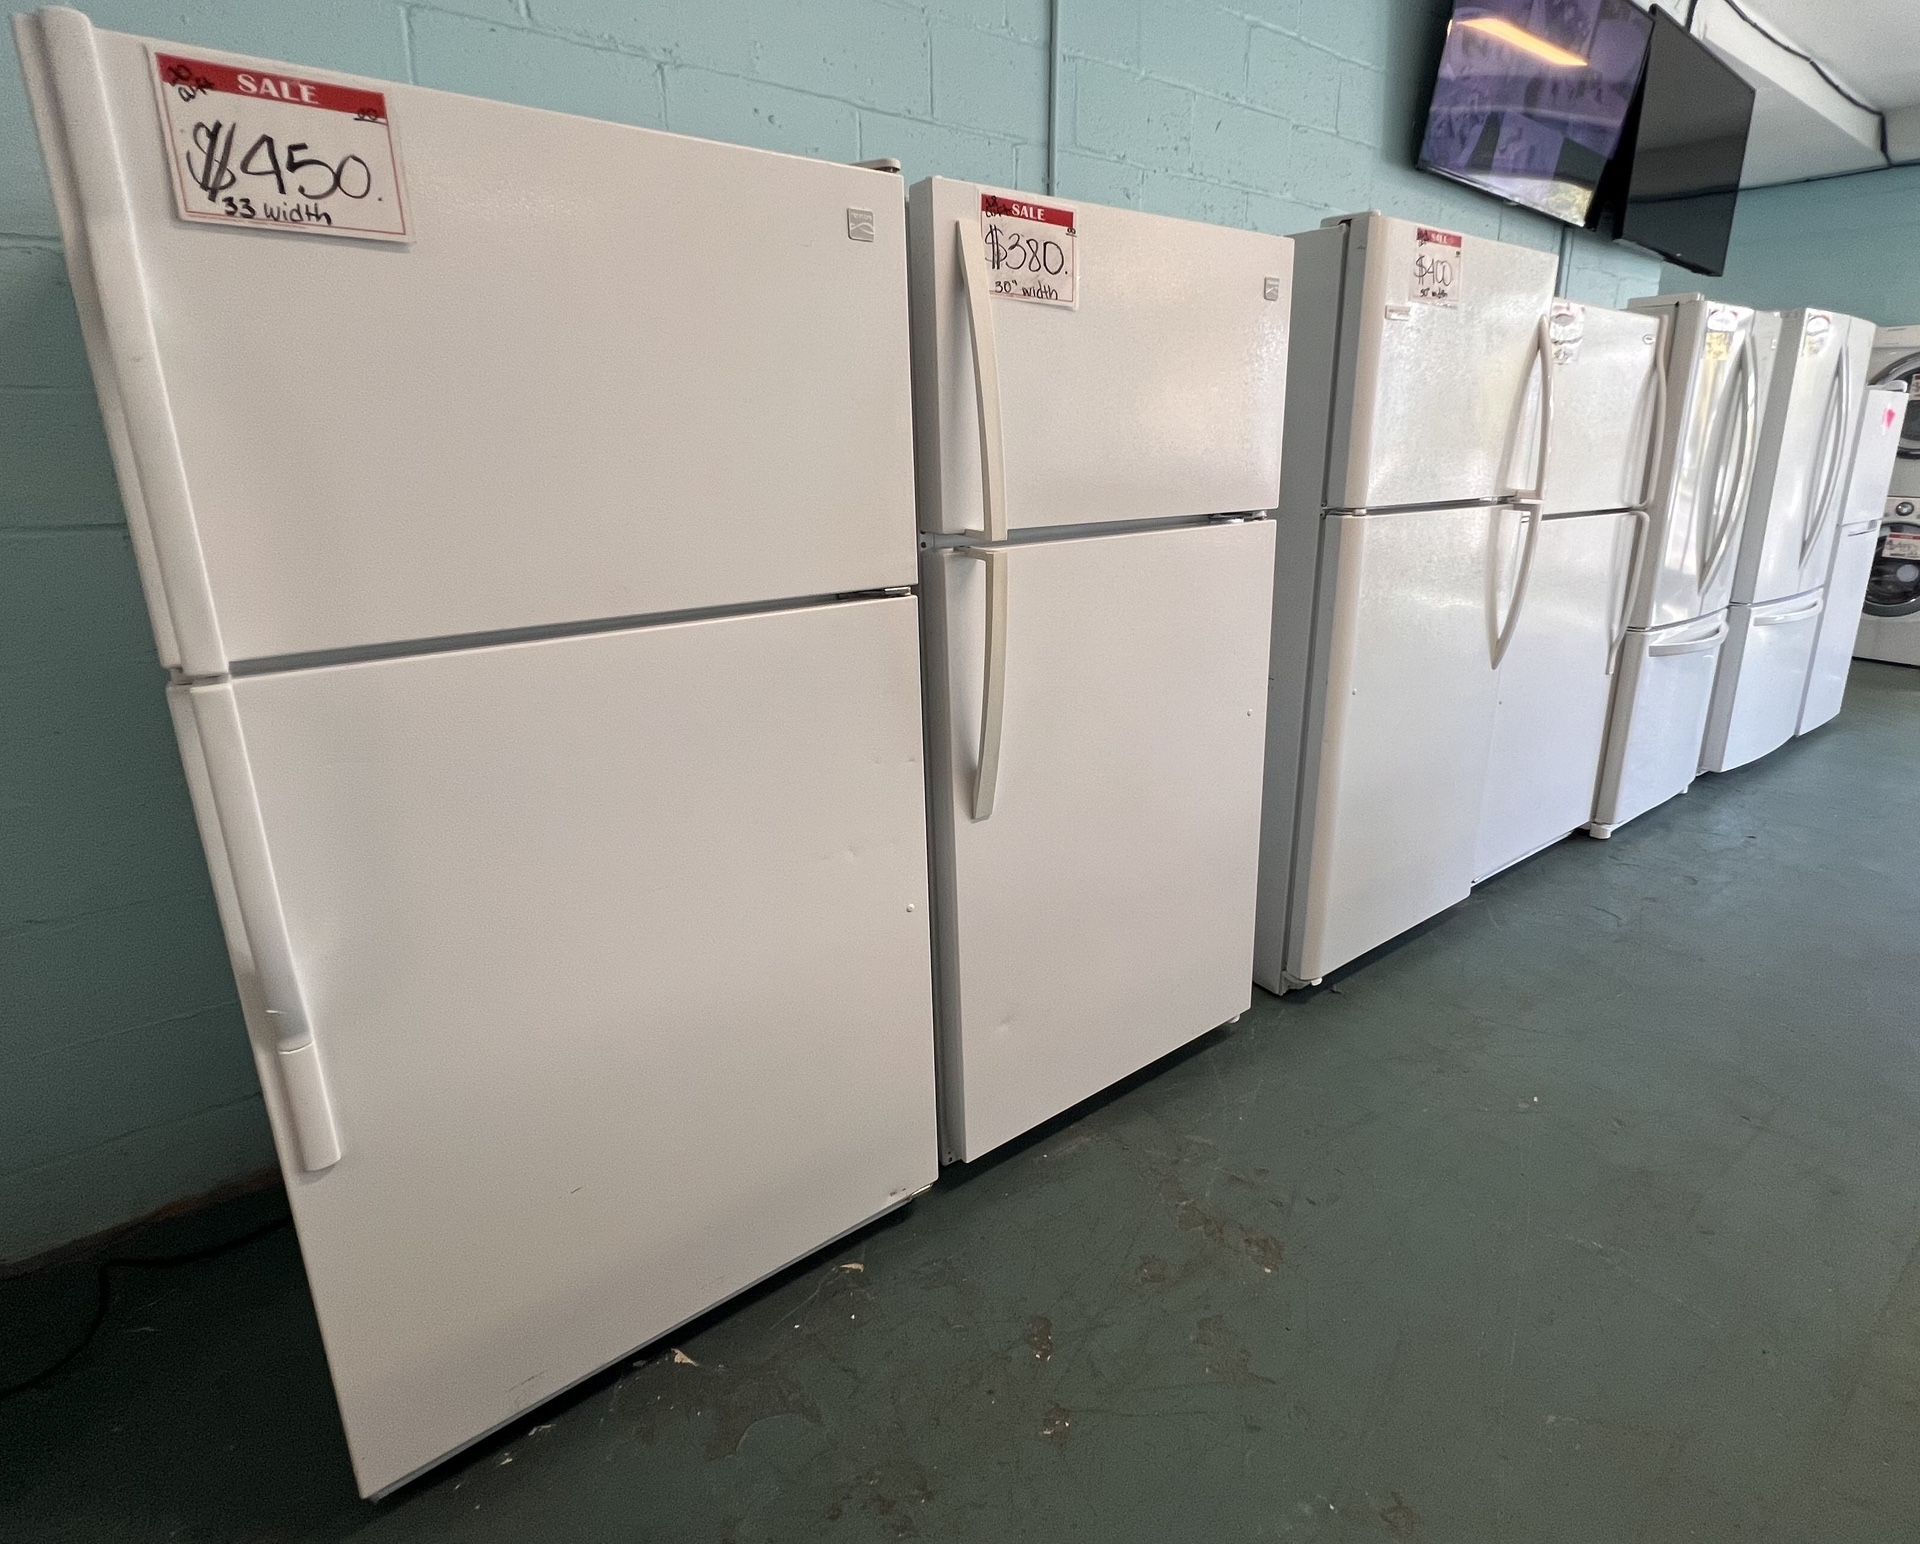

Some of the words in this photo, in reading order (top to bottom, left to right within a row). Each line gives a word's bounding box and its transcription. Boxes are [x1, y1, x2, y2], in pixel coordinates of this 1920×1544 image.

[236, 73, 320, 105] SALE
[221, 196, 256, 219] 33
[1011, 204, 1046, 221] SALE
